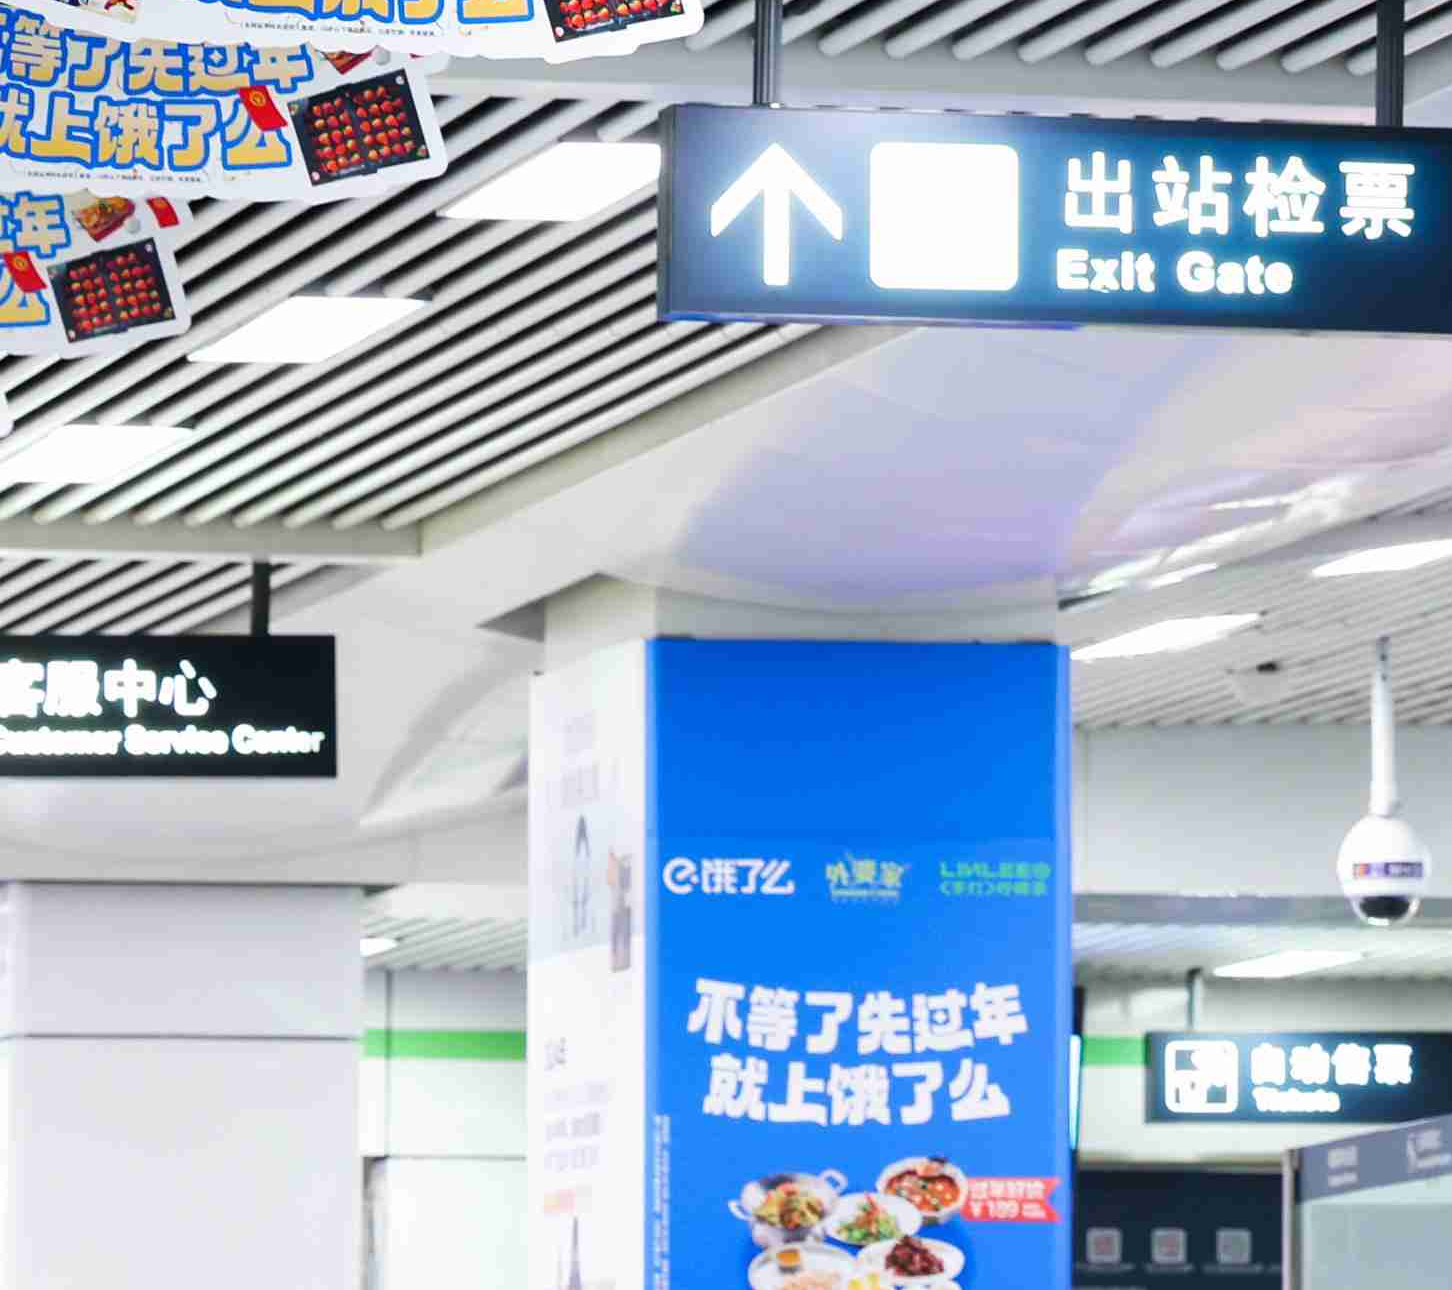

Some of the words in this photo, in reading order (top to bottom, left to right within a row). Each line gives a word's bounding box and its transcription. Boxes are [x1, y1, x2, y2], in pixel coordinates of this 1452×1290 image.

[0, 12, 314, 94] 等了先过年
[1062, 150, 1416, 240] 出站检票
[1056, 248, 1156, 294] Exit
[1176, 251, 1294, 296] Gate
[686, 976, 1030, 1056] 不等了先过年
[702, 1054, 1011, 1127] 就上饿了么
